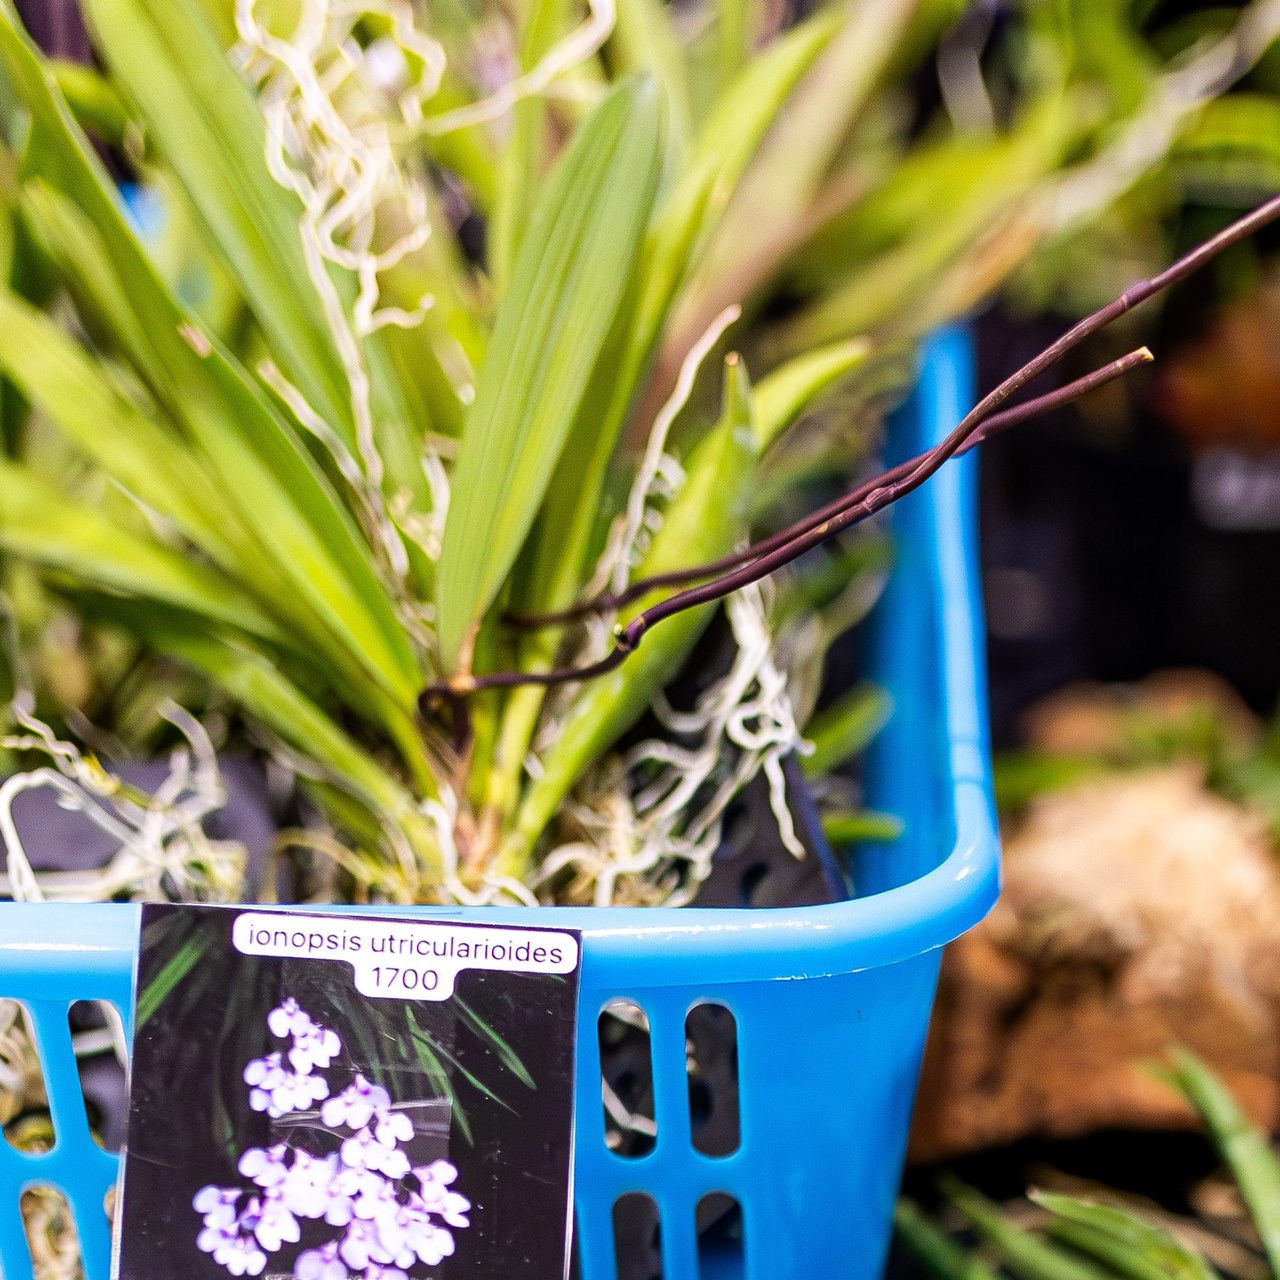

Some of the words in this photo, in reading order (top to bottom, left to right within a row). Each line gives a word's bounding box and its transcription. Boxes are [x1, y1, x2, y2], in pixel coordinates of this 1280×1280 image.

[249, 924, 361, 952] ionopsis
[371, 933, 563, 964] utricularioides
[371, 967, 439, 991] 1700
